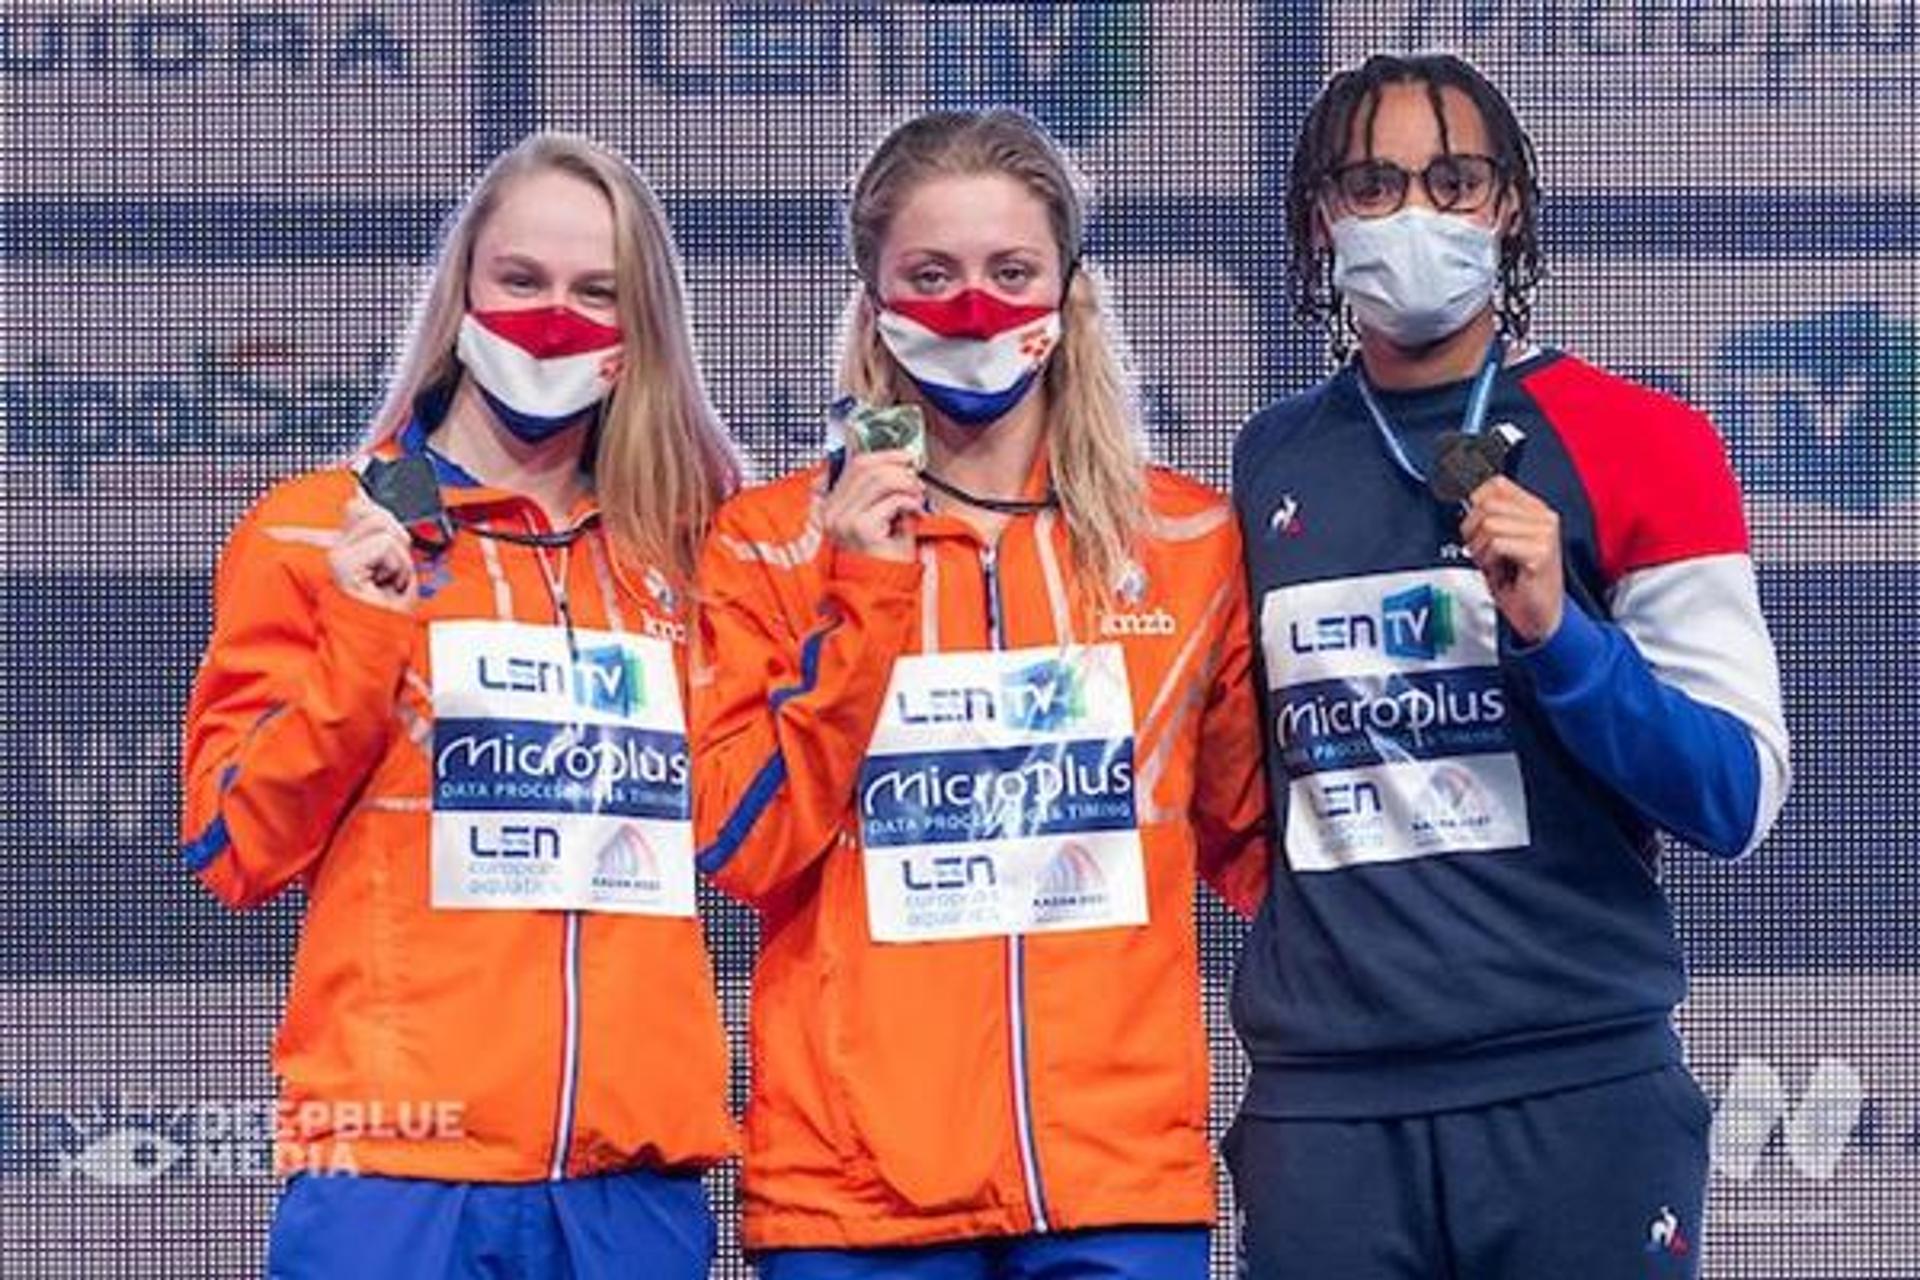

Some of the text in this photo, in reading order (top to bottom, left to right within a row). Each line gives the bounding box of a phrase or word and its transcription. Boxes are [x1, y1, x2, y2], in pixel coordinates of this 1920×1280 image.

[1290, 607, 1430, 655] LEN TV
[477, 654, 622, 699] LEN TV
[897, 686, 996, 725] LEN
[469, 825, 561, 859] LEN
[902, 854, 997, 891] LEN
